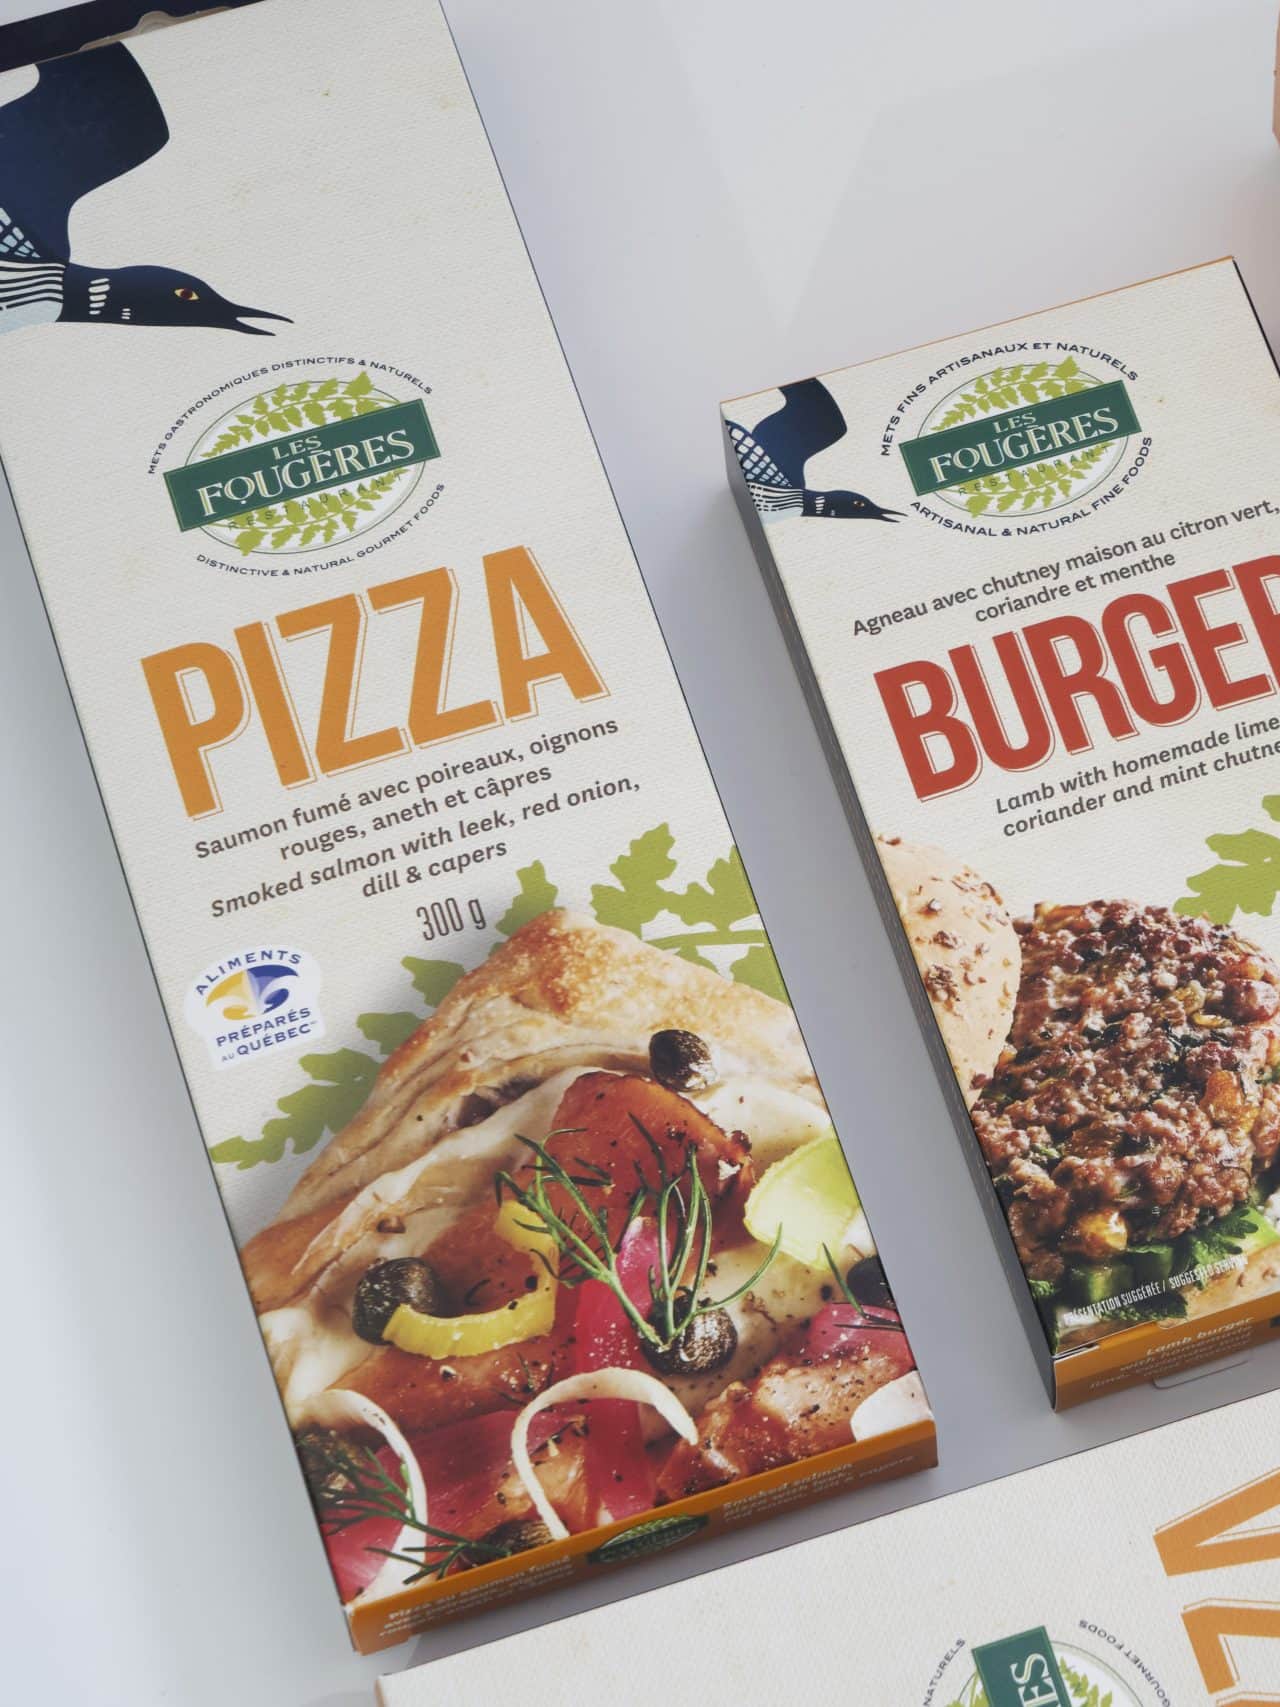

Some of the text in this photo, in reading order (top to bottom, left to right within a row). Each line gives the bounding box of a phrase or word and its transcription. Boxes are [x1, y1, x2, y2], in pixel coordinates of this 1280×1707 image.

[147, 356, 432, 475] METS GASTRONOMIQUES DISTINCTIFS & NATURELS
[880, 342, 1139, 457] METS FINS ARTISANAUX ET NATURELS
[992, 411, 1037, 434] LES
[196, 428, 415, 517] FOUGÈRES
[272, 434, 323, 460] LES
[910, 436, 1153, 537] ARTISANAL & NATURAL FINE FOODS
[928, 406, 1119, 484] FOUGÈRES
[196, 484, 446, 577] DISTINCTIVE & NATURAL GOURMET FOODS
[853, 498, 1280, 637] Agneau avec chutney maison au citron vert,
[974, 550, 1177, 623] coriandre et menthe
[140, 545, 611, 822] PIZZA
[195, 719, 619, 859] Saumon fumé avec poireaux, oignons
[280, 766, 552, 861] rouges, aneth et câpres
[996, 781, 1056, 815] Lamb
[1059, 762, 1109, 796] with
[1111, 727, 1231, 779] homemade
[1002, 791, 1107, 838] coriander
[1111, 774, 1156, 804] and
[1158, 756, 1210, 789] mint
[211, 776, 640, 918] Smoked salmon with leek, red onion,
[362, 840, 508, 898] dill & capers
[416, 897, 487, 942] 300 g
[196, 950, 302, 996] ALIMENTS
[216, 1008, 311, 1047] PRÉPARÉS
[1078, 1619, 1125, 1650] FOODS
